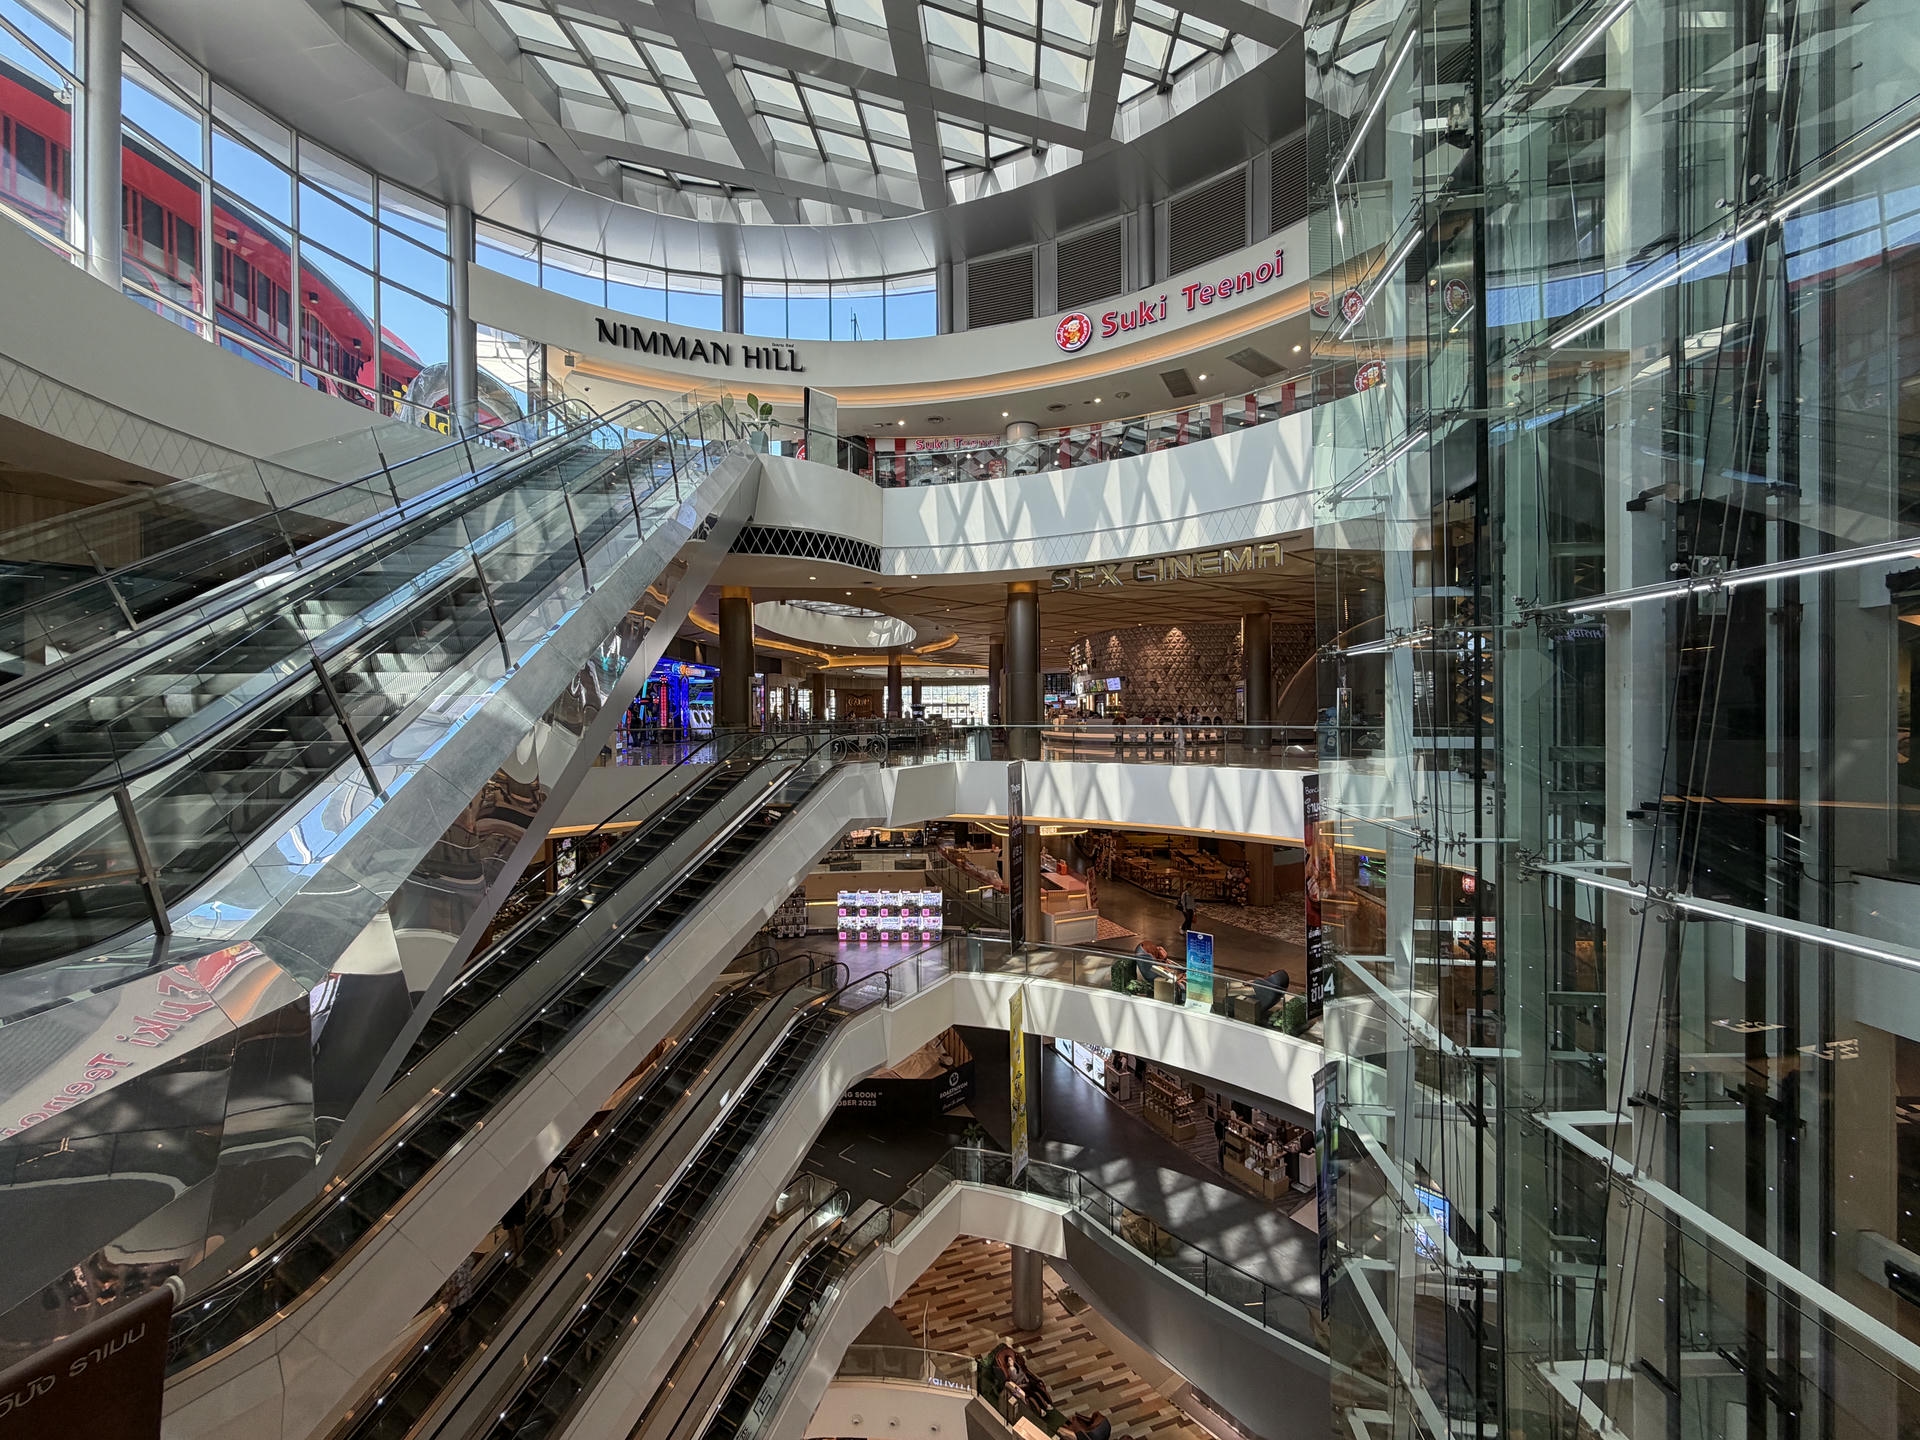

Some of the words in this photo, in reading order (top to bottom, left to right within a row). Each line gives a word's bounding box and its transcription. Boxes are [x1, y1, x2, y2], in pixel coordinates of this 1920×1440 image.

[1101, 295, 1167, 337] Suki
[1182, 249, 1284, 311] Teenoi
[595, 317, 730, 366] NIMMAN
[742, 345, 804, 373] HILL
[915, 438, 949, 450] Suki
[1132, 542, 1285, 582] CINEMA
